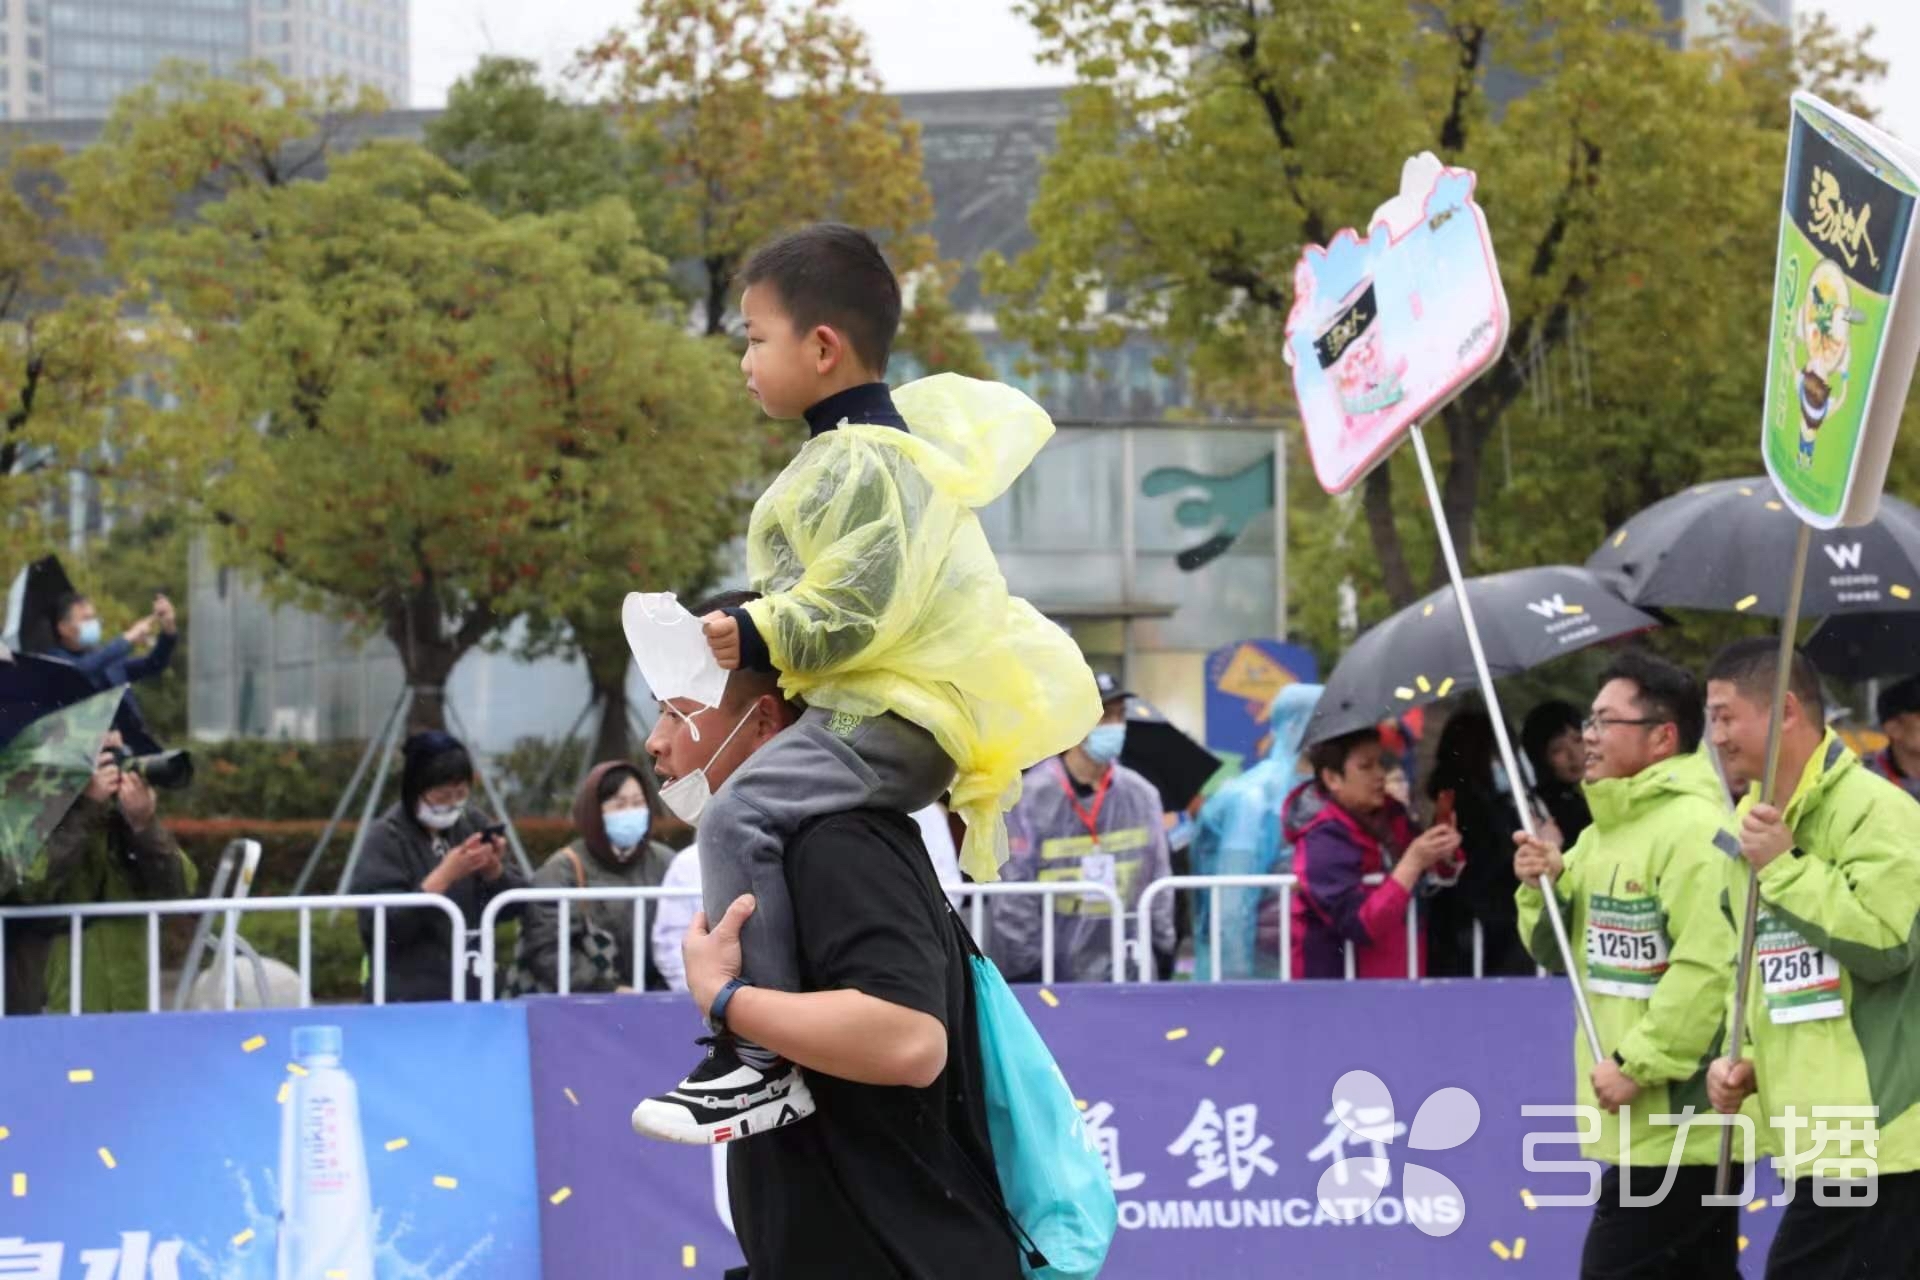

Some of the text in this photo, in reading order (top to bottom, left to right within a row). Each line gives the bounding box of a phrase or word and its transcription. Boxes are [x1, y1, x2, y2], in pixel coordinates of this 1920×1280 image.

[1823, 542, 1863, 570] W
[1758, 949, 1825, 984] 12581
[1117, 1195, 1462, 1230] OMMUNICATIONS
